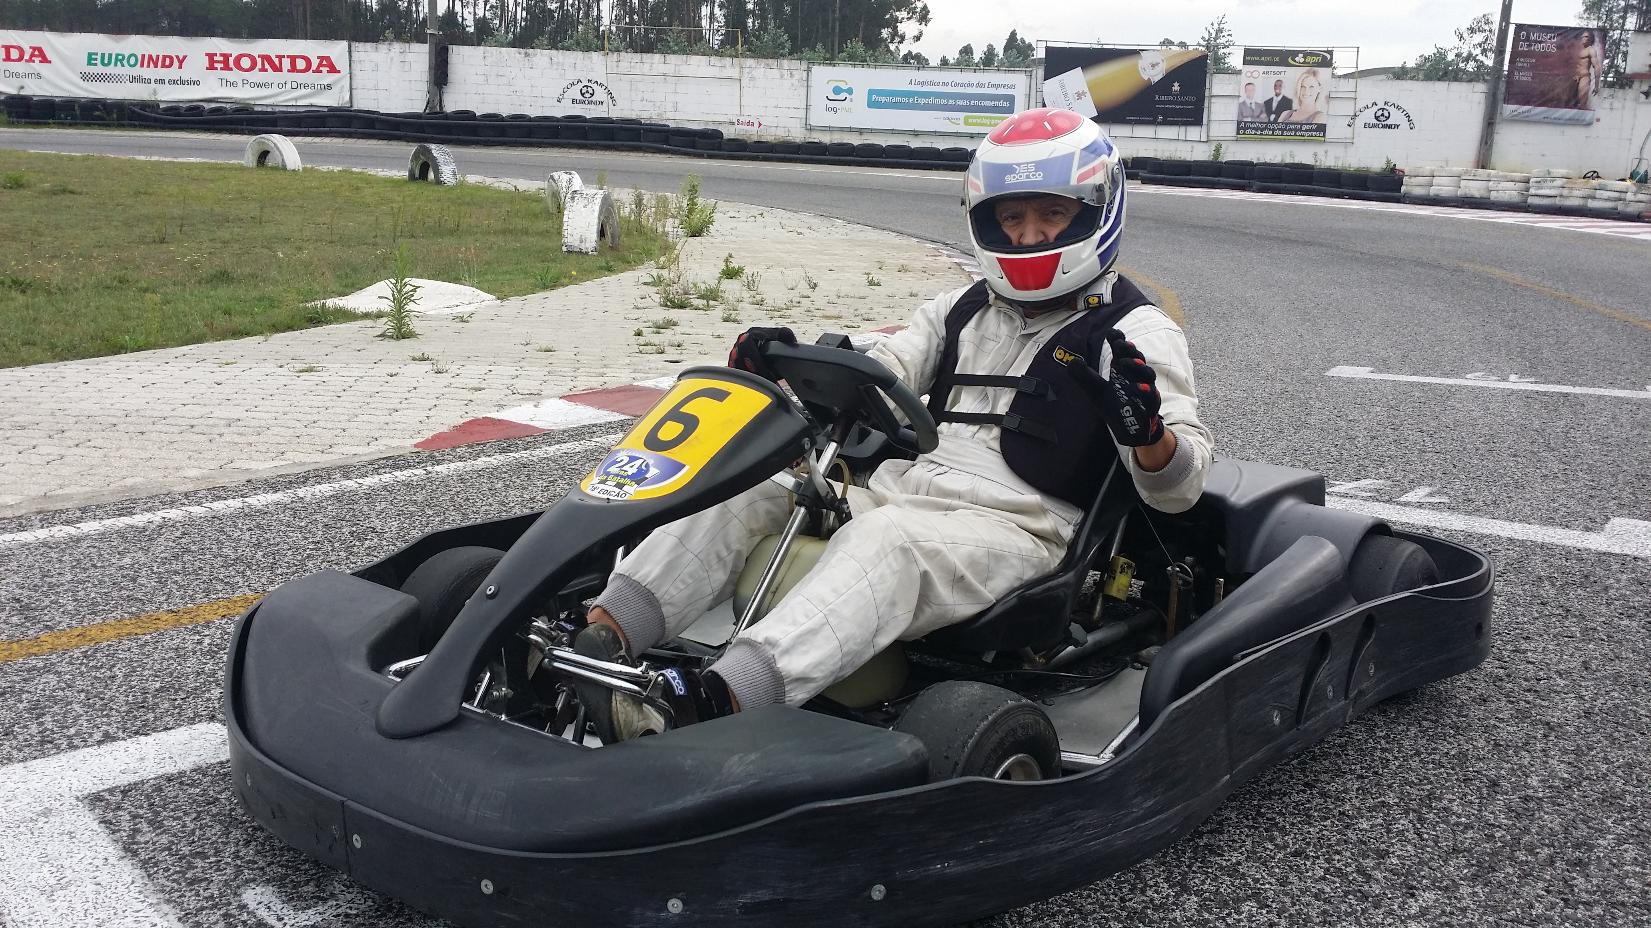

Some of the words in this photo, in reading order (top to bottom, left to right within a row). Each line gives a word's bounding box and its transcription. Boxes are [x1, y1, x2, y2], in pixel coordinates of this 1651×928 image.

[1520, 31, 1526, 40] O
[1530, 32, 1557, 42] MUSEU
[1518, 42, 1528, 51] DE
[1531, 42, 1557, 53] TODOS
[86, 51, 188, 70] EUROINDY
[205, 52, 341, 74] HONDA
[1305, 55, 1323, 64] apri
[3, 69, 42, 80] Dreams
[128, 76, 152, 85] Utiliza
[153, 78, 166, 86] em
[168, 77, 201, 87] exclusivo
[218, 78, 238, 88] The
[242, 79, 275, 91] Power
[277, 79, 288, 90] of
[290, 80, 333, 91] Dreams
[914, 79, 940, 89] Logística
[950, 80, 974, 90] Coração
[975, 81, 987, 89] das
[987, 82, 1016, 91] Empresas
[557, 78, 583, 103] ESCOLA
[587, 78, 618, 107] KARTING
[571, 98, 604, 106] EUROINDY
[872, 95, 909, 105] Preparamos
[914, 96, 948, 107] Expedimos
[970, 99, 1010, 108] encomendas
[1347, 101, 1378, 128] ESCOLA
[1383, 100, 1416, 131] KARTING
[1267, 122, 1286, 130] opção
[1363, 122, 1401, 130] EUROINDY
[1004, 171, 1043, 183] sparco
[643, 387, 732, 452] 6
[1121, 405, 1141, 434] GEL
[606, 455, 646, 475] 24
[607, 474, 636, 488] Batalha
[598, 488, 627, 499] EDIÇÃO
